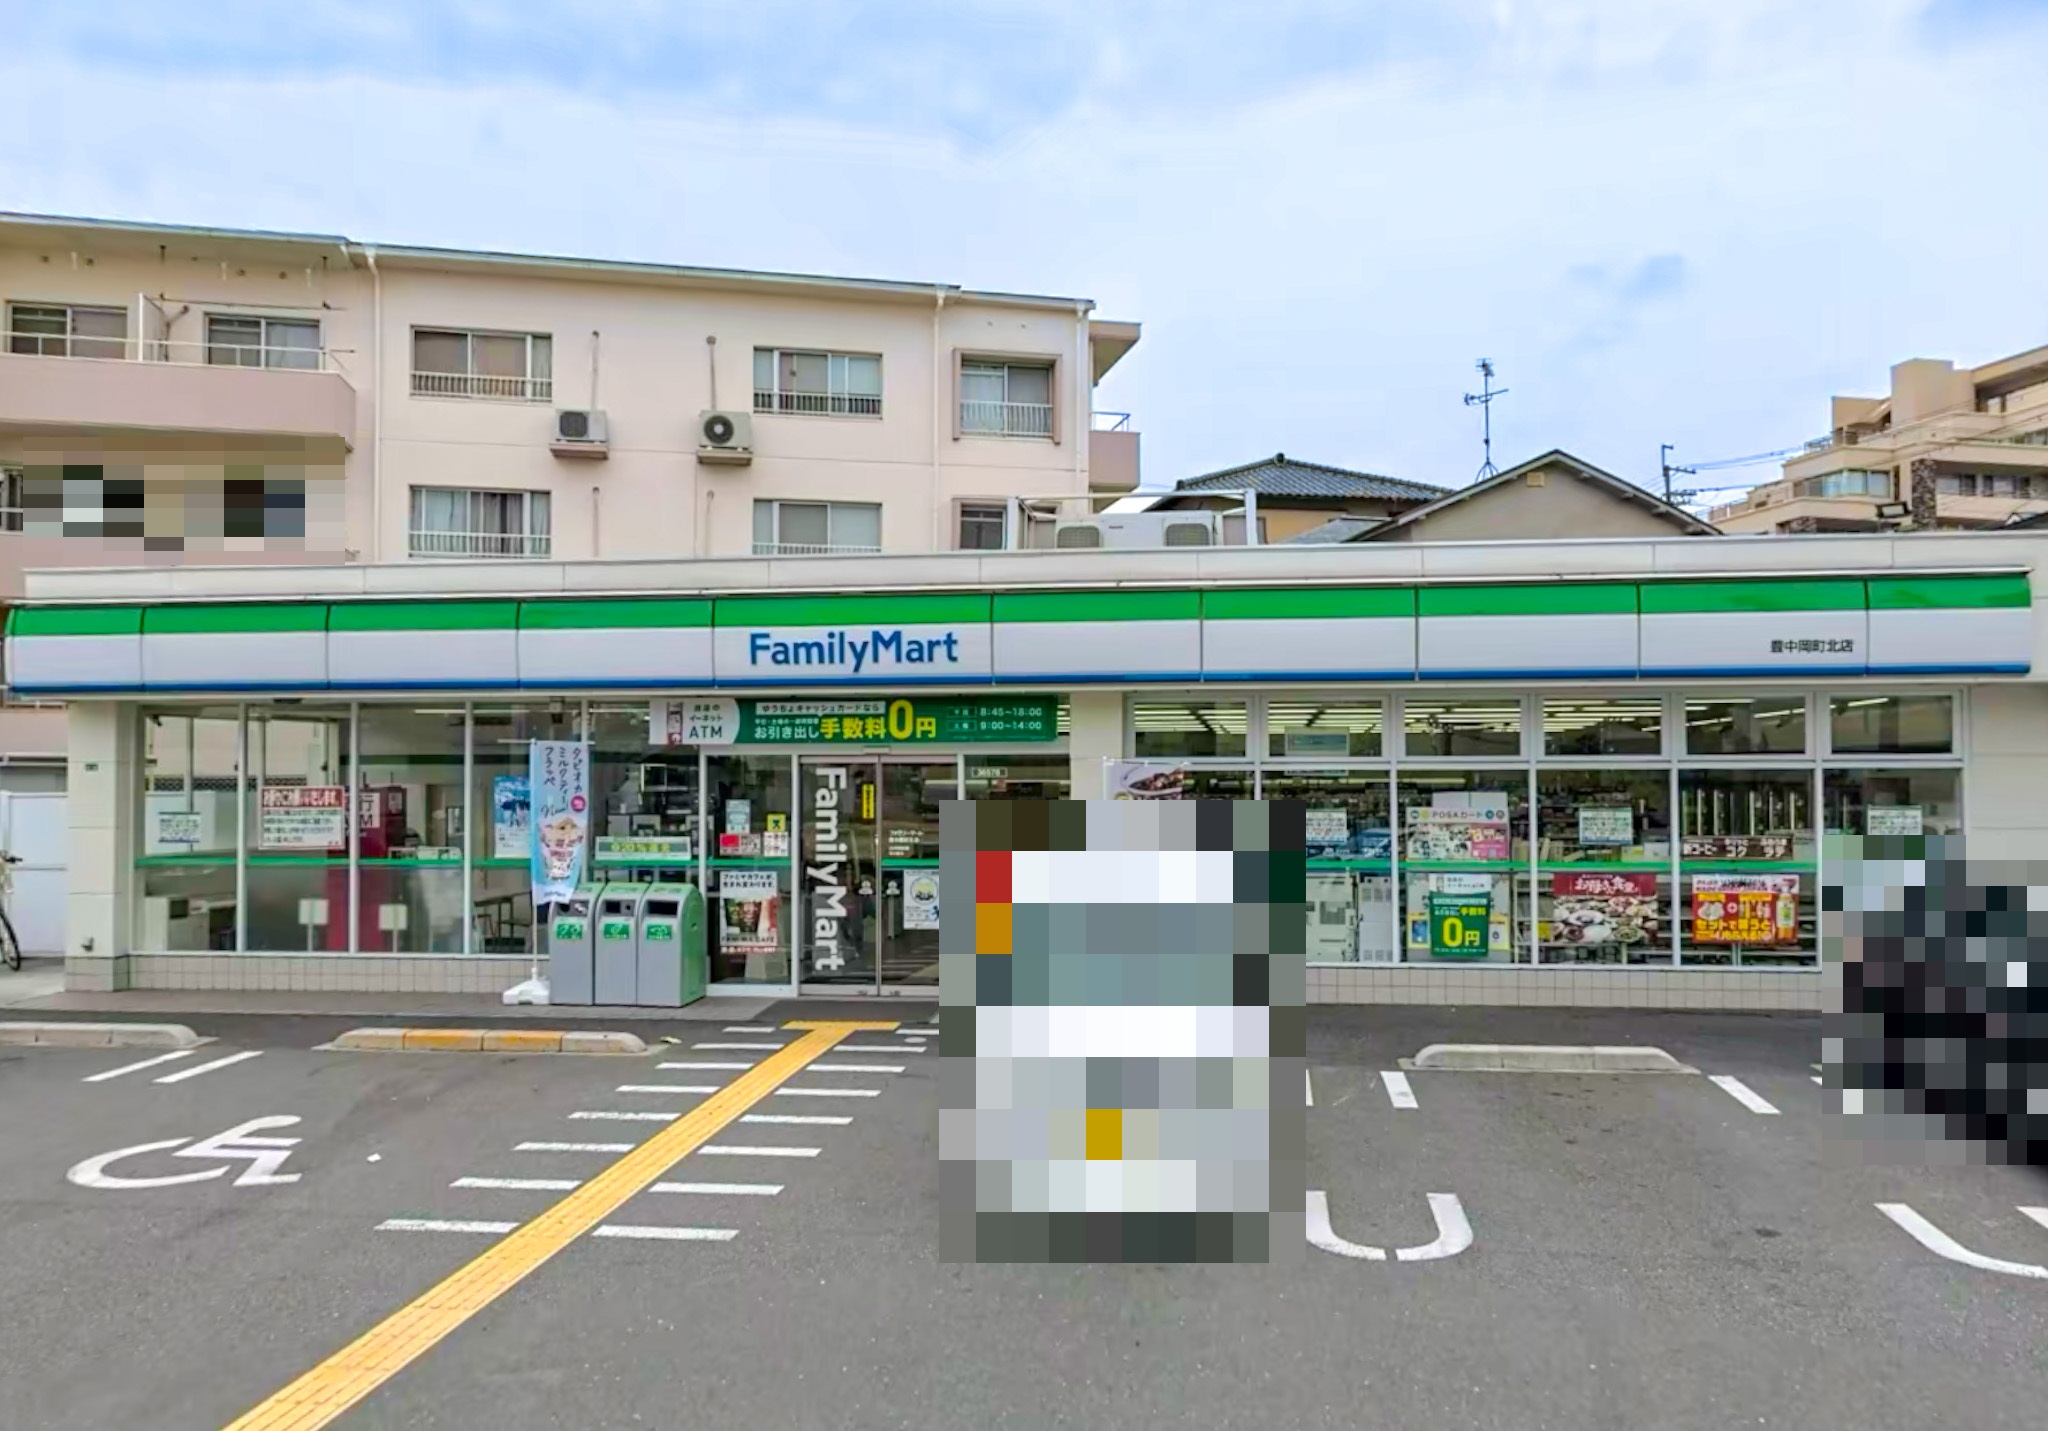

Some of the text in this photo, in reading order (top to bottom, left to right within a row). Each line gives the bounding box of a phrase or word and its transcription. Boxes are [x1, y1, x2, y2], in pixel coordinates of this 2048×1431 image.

[750, 631, 958, 673] FamilyMart
[1770, 638, 1854, 654] 豊中岡町北店
[689, 724, 723, 739] ATM
[543, 746, 556, 787] フラッペ
[572, 747, 584, 793] タピオカ
[806, 767, 848, 971] FamilyMart
[1442, 916, 1480, 947] 0円
